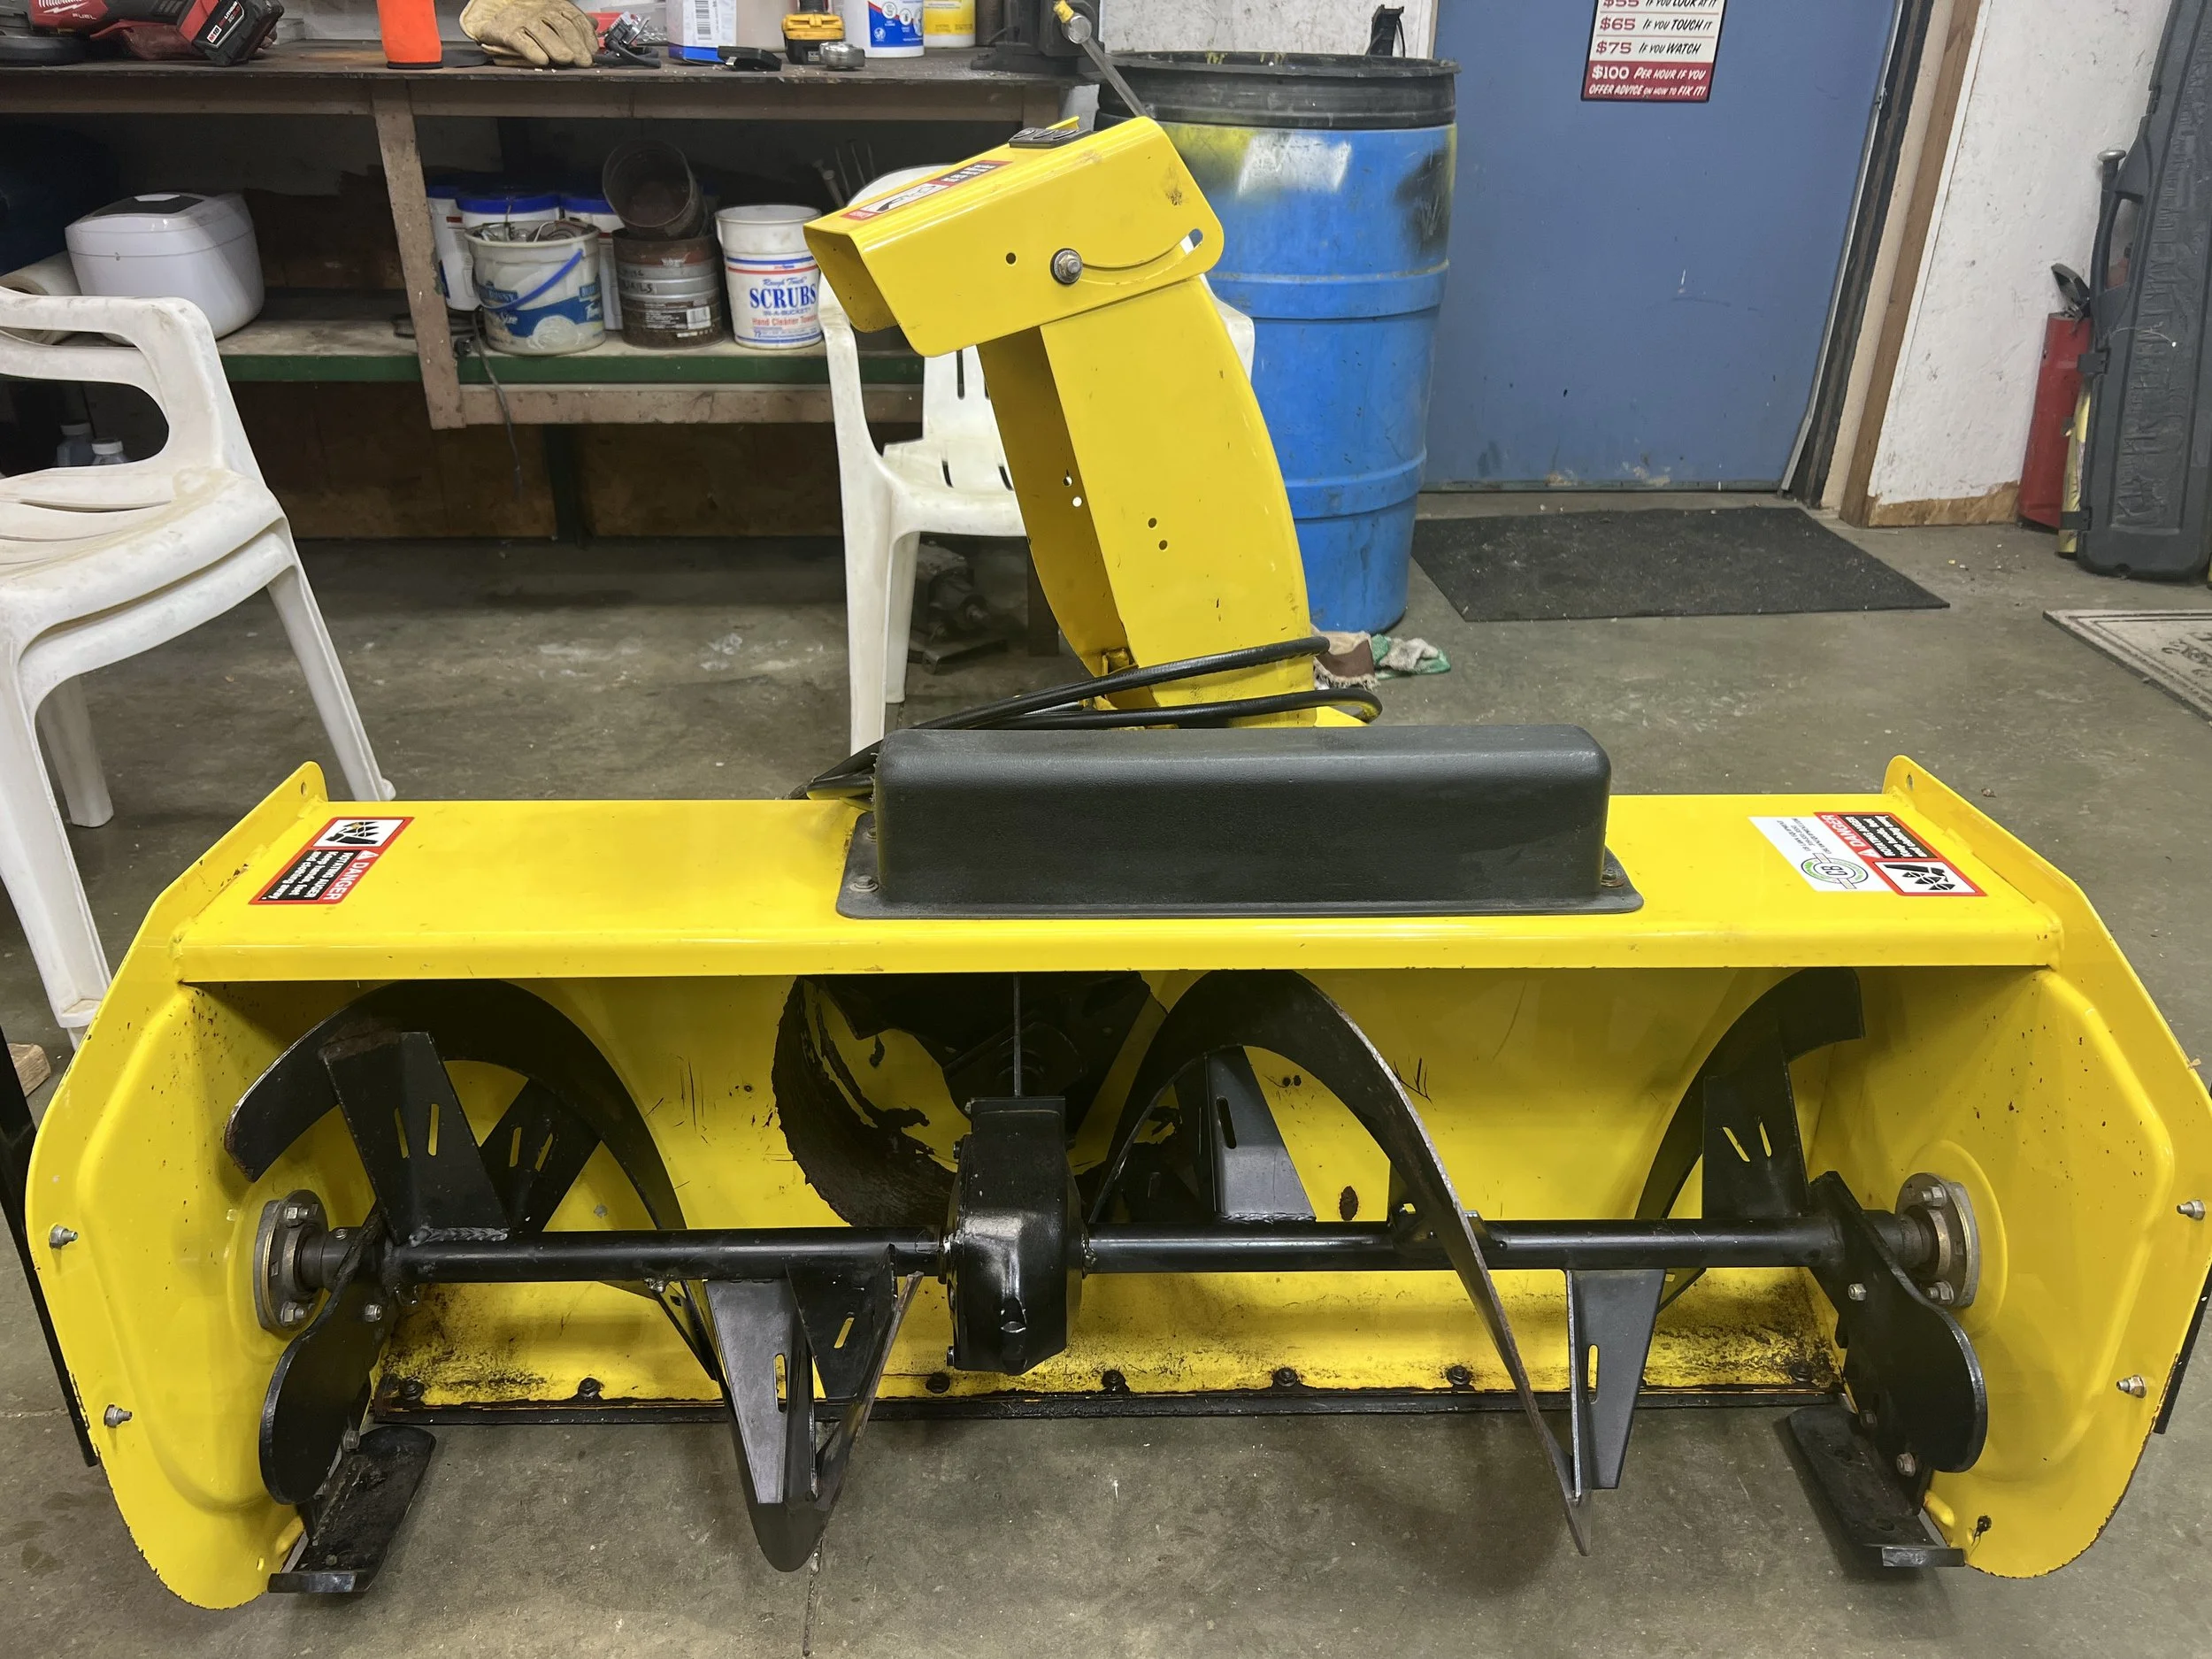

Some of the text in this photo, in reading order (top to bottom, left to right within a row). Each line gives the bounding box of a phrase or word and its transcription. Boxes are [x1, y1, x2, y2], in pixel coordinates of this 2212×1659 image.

[1600, 17, 1636, 31] $65
[1671, 19, 1704, 31] TOUCH
[1596, 41, 1632, 55] $75
[1666, 42, 1701, 55] WATCH
[1592, 65, 1630, 80] $100
[1588, 84, 1615, 95] OFFER
[1614, 84, 1644, 96] ADVICE
[1678, 86, 1694, 96] FIX
[749, 283, 817, 310] SCRUBS
[1821, 815, 1867, 847] DANGER
[1845, 816, 1896, 856] ROTATING AUGER
[306, 851, 322, 862] and
[1893, 844, 1913, 857] Keep
[317, 851, 339, 865] Keep
[282, 862, 311, 884] clothing
[303, 852, 355, 898] ROTATING AUGER
[1821, 865, 1848, 875] CB
[323, 862, 370, 901] DANGER
[288, 885, 308, 896] feet
